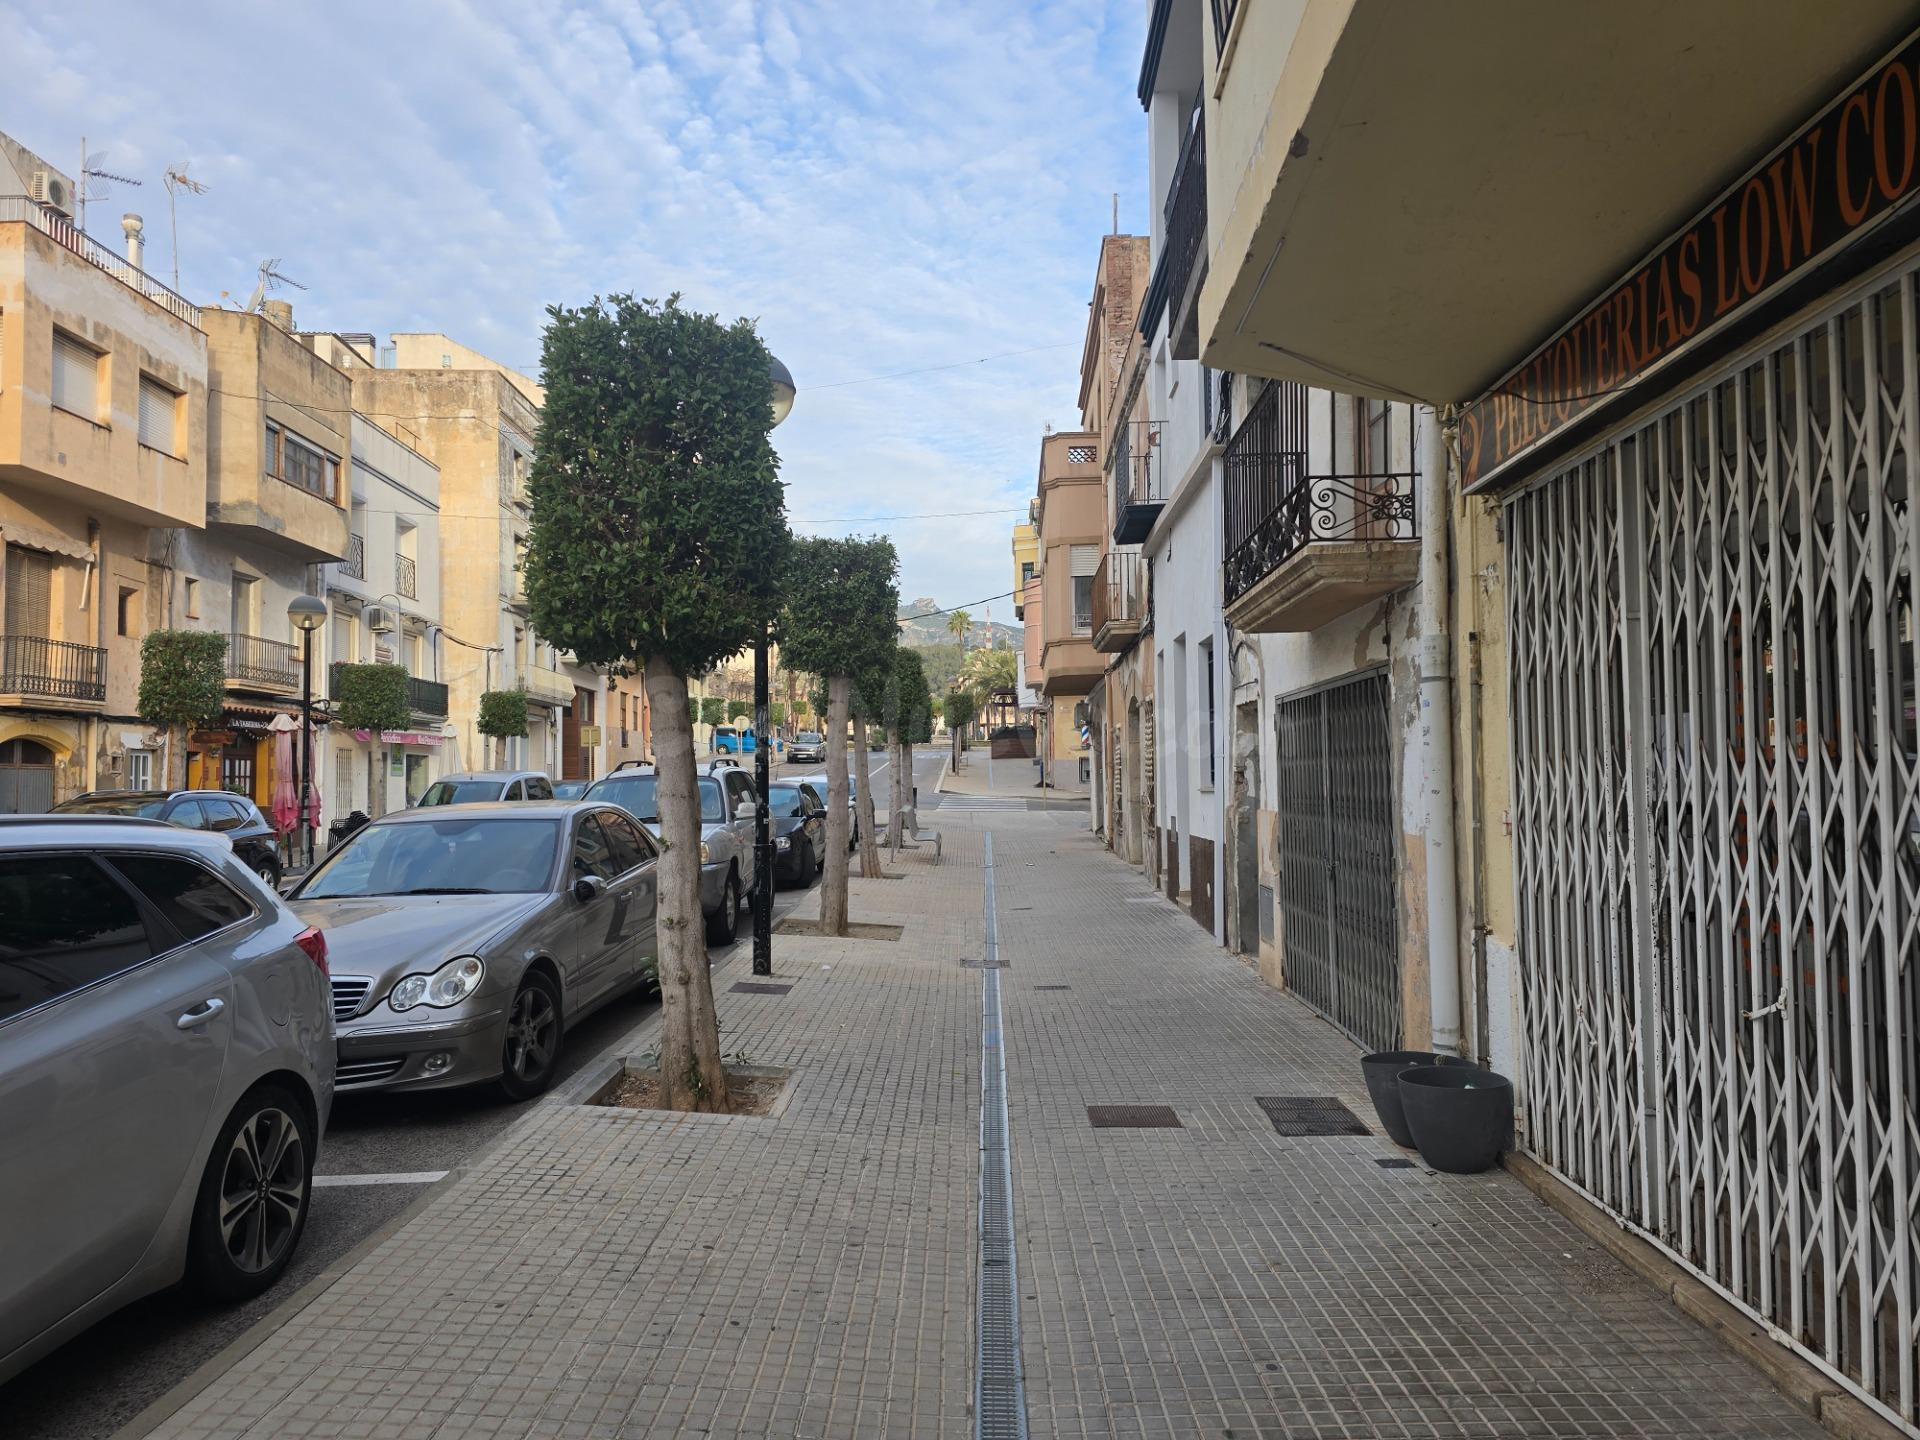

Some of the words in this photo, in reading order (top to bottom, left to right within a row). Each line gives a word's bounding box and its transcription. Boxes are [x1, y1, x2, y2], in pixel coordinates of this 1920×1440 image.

[1493, 230, 1701, 464] PELUQUERIAS
[1712, 127, 1822, 318] LOW
[1835, 61, 1920, 228] CO
